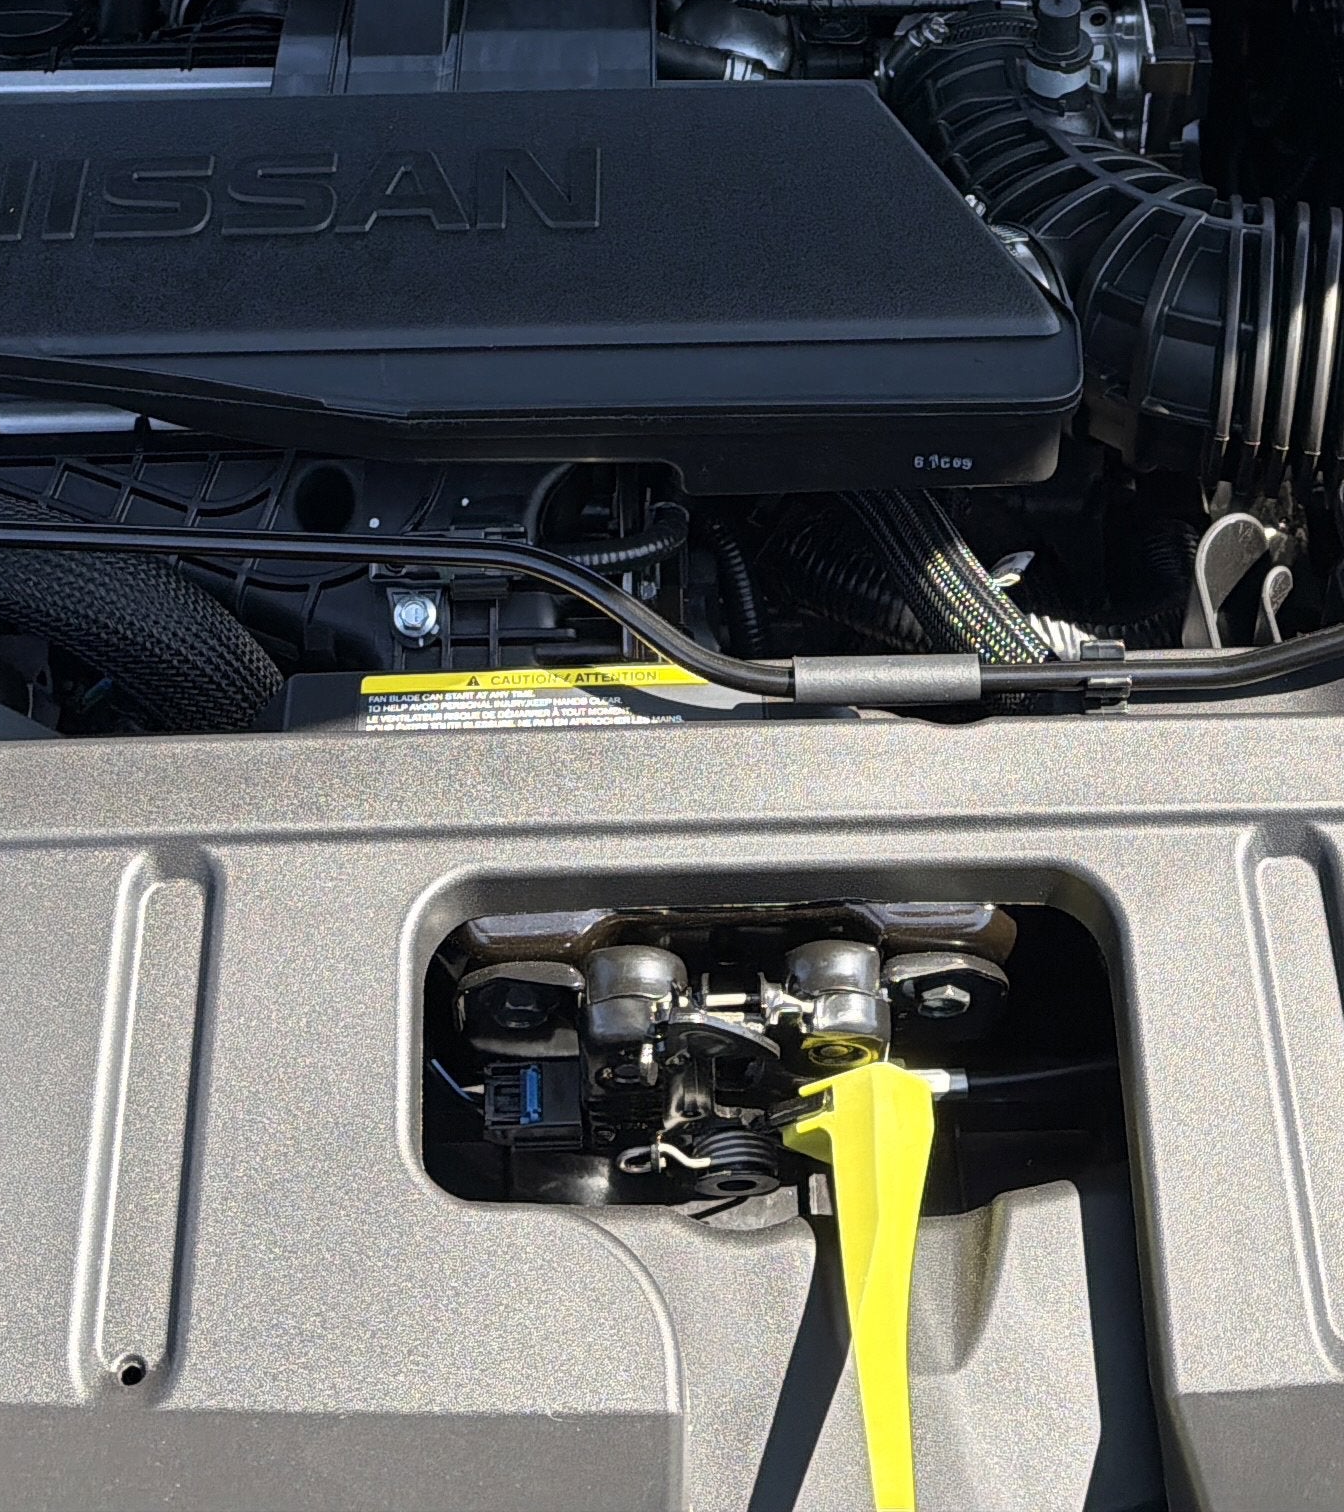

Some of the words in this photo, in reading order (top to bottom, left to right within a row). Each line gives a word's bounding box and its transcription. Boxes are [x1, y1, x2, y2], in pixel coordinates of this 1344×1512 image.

[490, 673, 556, 685] CAUTION
[574, 670, 657, 683] ATTENTION
[368, 695, 387, 703] FAN
[389, 694, 420, 703] BLADE
[422, 693, 444, 702] CAN
[445, 692, 474, 701] START
[476, 691, 488, 699] AT
[489, 691, 510, 699] ANY
[368, 705, 381, 713] TO
[383, 704, 408, 713] HELP
[409, 703, 439, 711] AVOID
[441, 701, 492, 710] PERSONAL
[553, 697, 587, 705] HANDS
[367, 715, 379, 724] LE
[482, 711, 496, 719] DE
[562, 707, 587, 717] TOUT
